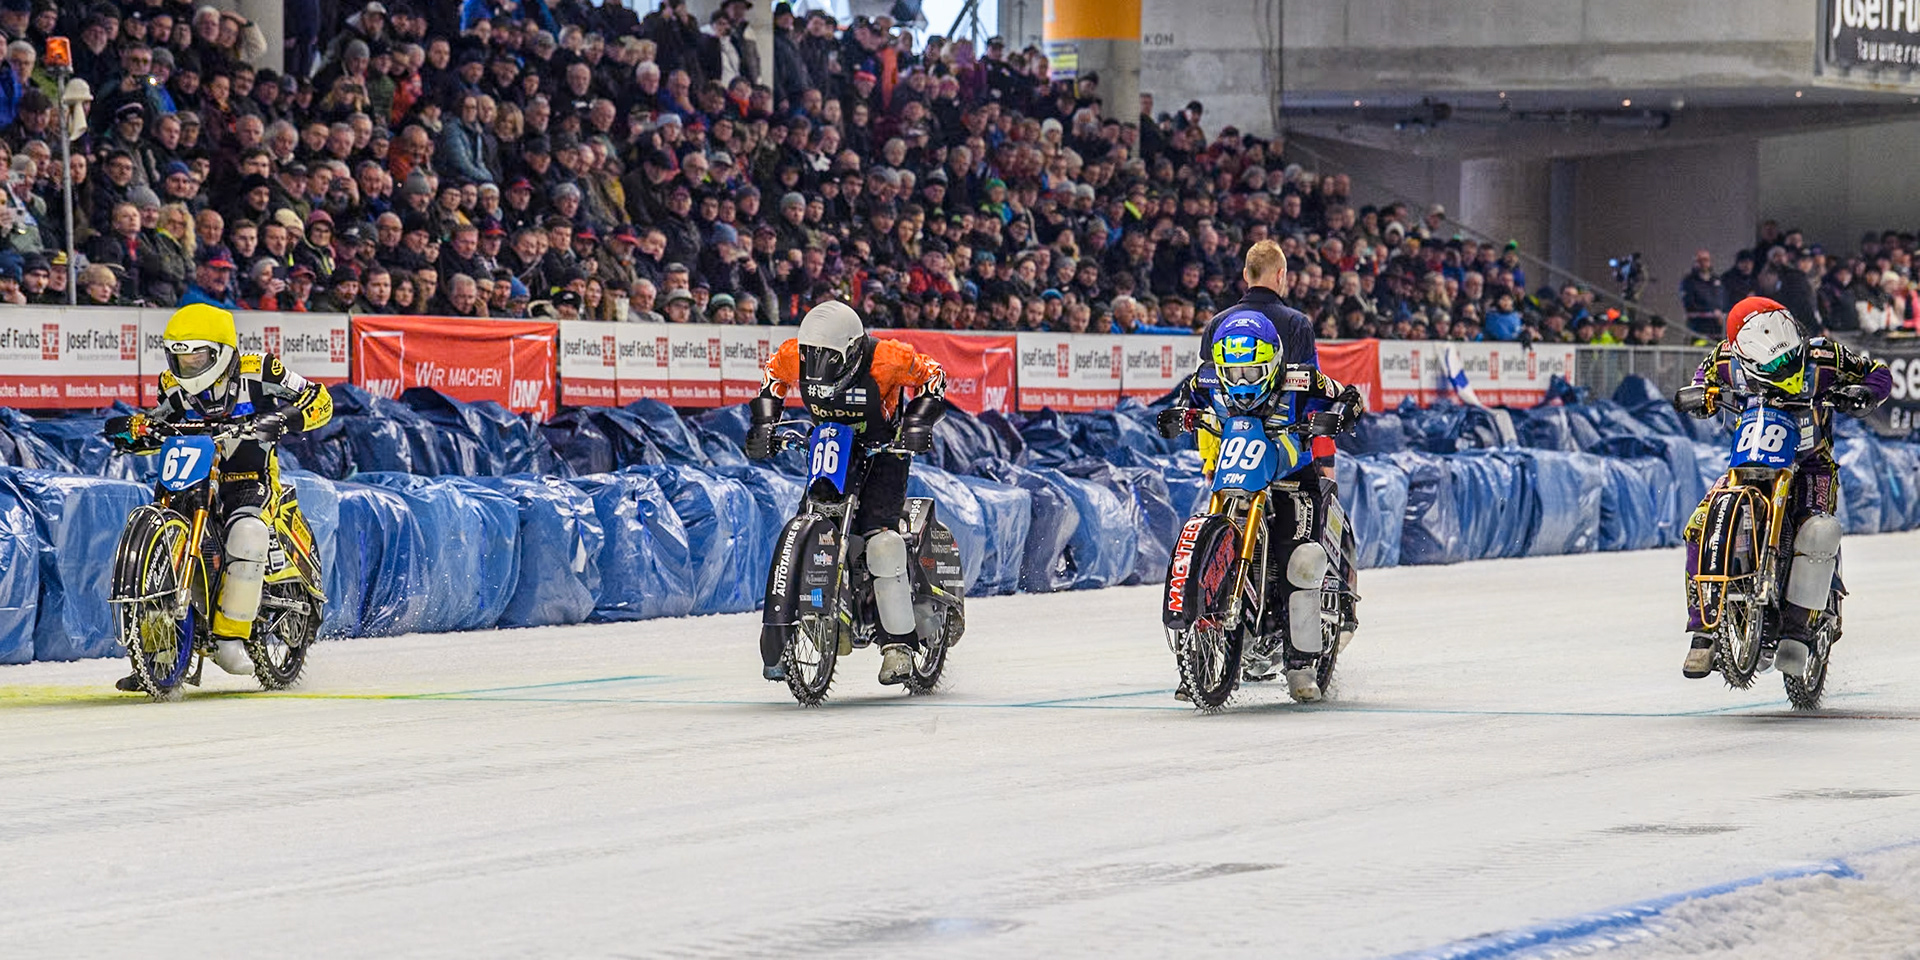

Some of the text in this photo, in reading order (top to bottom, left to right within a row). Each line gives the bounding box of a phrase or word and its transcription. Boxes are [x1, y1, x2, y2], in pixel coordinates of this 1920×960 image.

[13, 328, 40, 349] Fuchs
[66, 328, 119, 354] Josef Fuchs
[239, 332, 262, 351] Fuchs
[283, 333, 329, 356] Josef Fuchs
[449, 367, 503, 388] MACHEN
[1737, 422, 1787, 453] 88
[161, 447, 201, 481] 67
[811, 440, 840, 475] 66
[1216, 436, 1267, 471] 199
[1222, 473, 1247, 484] FIM
[776, 529, 798, 598] AUTOTARVIKE
